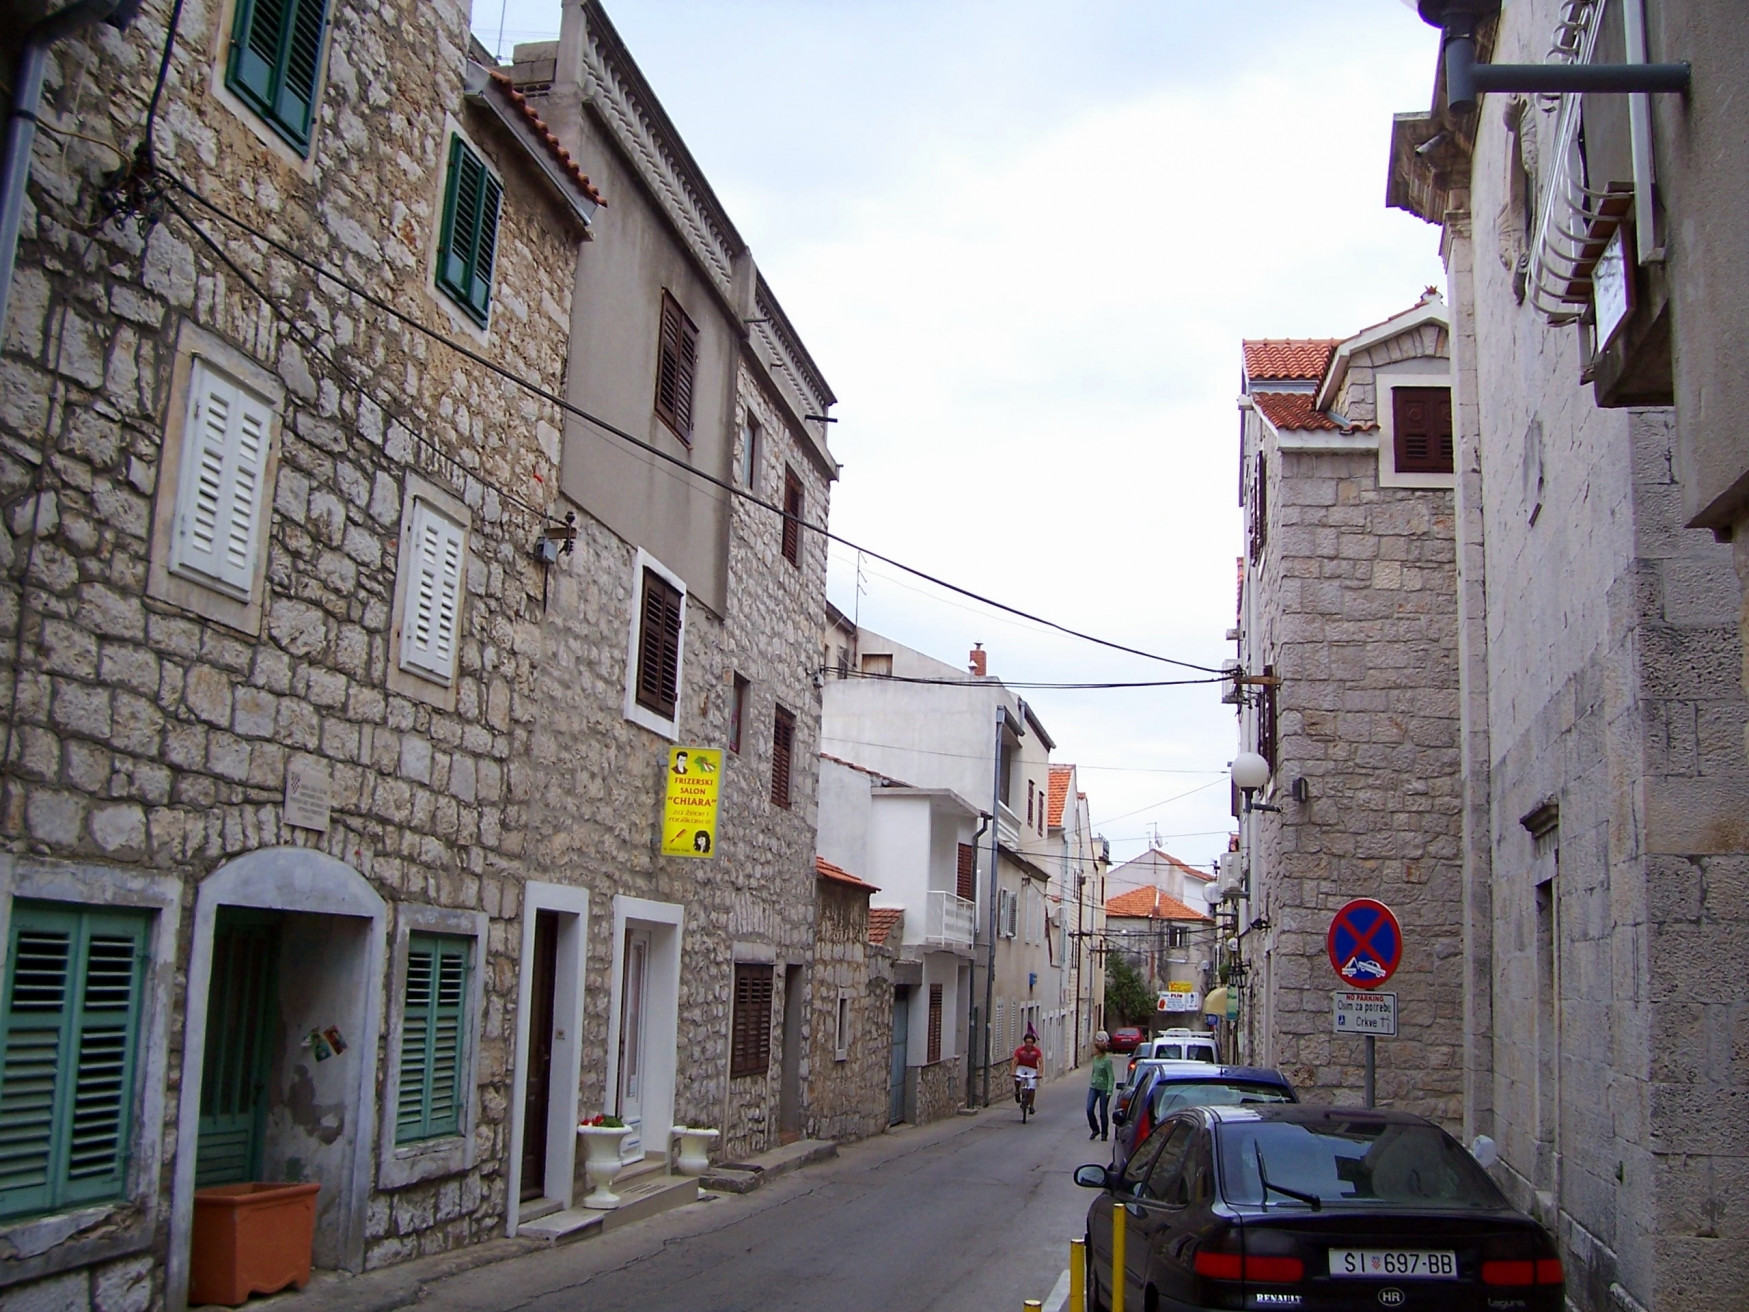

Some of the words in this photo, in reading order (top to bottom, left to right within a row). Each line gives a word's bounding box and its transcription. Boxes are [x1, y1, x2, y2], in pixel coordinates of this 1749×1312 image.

[674, 776, 713, 786] FRIZERSKI
[680, 787, 706, 795] SALON
[1356, 994, 1384, 1003] PARKING
[1355, 1003, 1363, 1011] za
[1356, 1016, 1377, 1028] Crkve
[1384, 1252, 1452, 1274] 697-BB
[1256, 1293, 1302, 1304] RENAULT
[1382, 1291, 1400, 1302] HR
